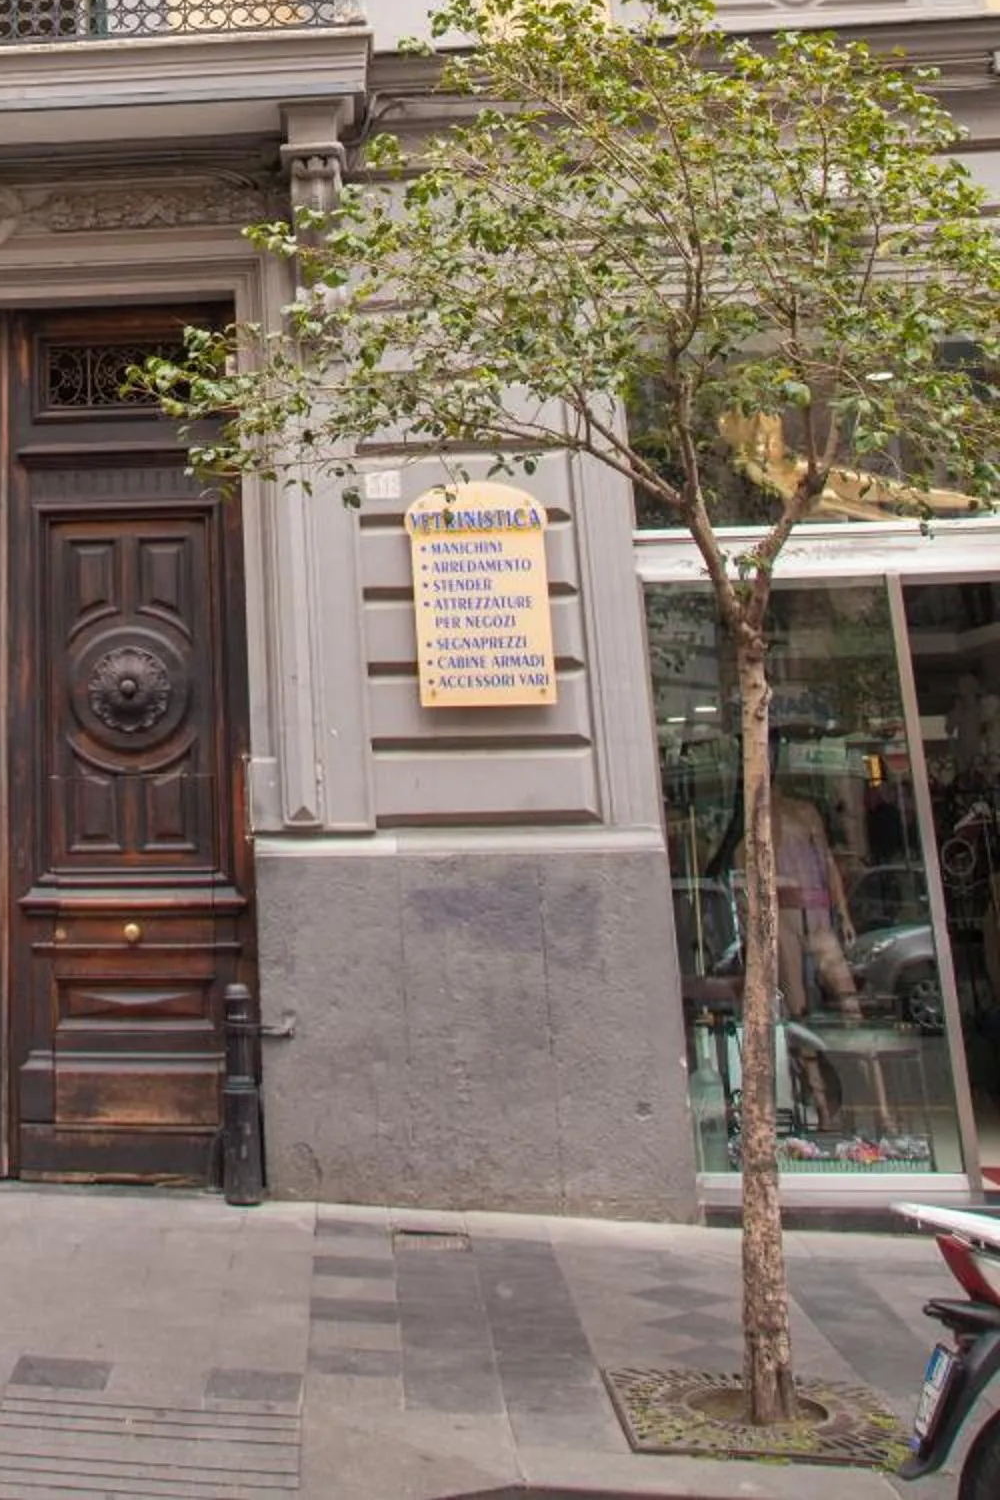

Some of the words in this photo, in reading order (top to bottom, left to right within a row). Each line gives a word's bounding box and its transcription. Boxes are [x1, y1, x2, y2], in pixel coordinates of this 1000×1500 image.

[431, 541, 503, 555] MANICHINI
[432, 558, 532, 573] ARREDAMENTO
[433, 578, 493, 592] STENDER
[434, 596, 533, 610] ATTREZZATURE
[435, 615, 461, 628] PER
[465, 614, 516, 628] NEGOZI
[436, 635, 527, 650] SEGNAPREZZI
[437, 656, 485, 669] CABINE
[492, 654, 545, 668] ARMADI
[439, 674, 515, 688] ACCESSORI
[519, 673, 549, 685] VARI
